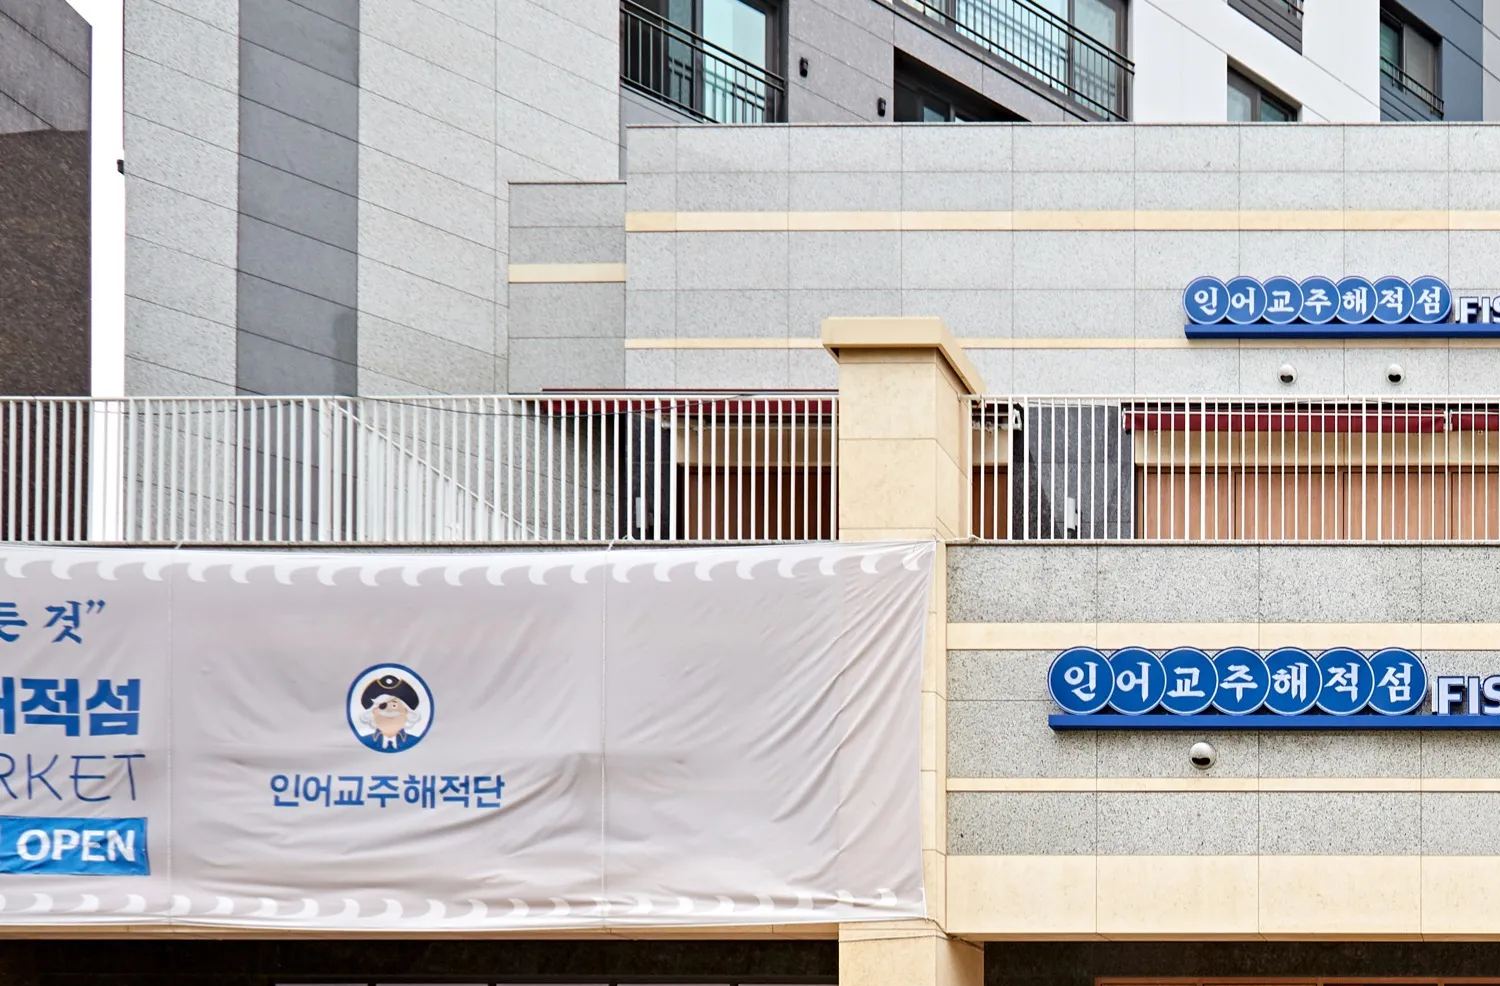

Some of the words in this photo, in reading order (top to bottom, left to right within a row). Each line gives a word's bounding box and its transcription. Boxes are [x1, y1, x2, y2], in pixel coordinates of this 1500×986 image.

[1193, 285, 1439, 314] 인어교주해적섬
[1063, 660, 1413, 704] 인어교주해적섬
[270, 772, 505, 811] 인어교주해적단
[16, 829, 137, 862] OPEN
